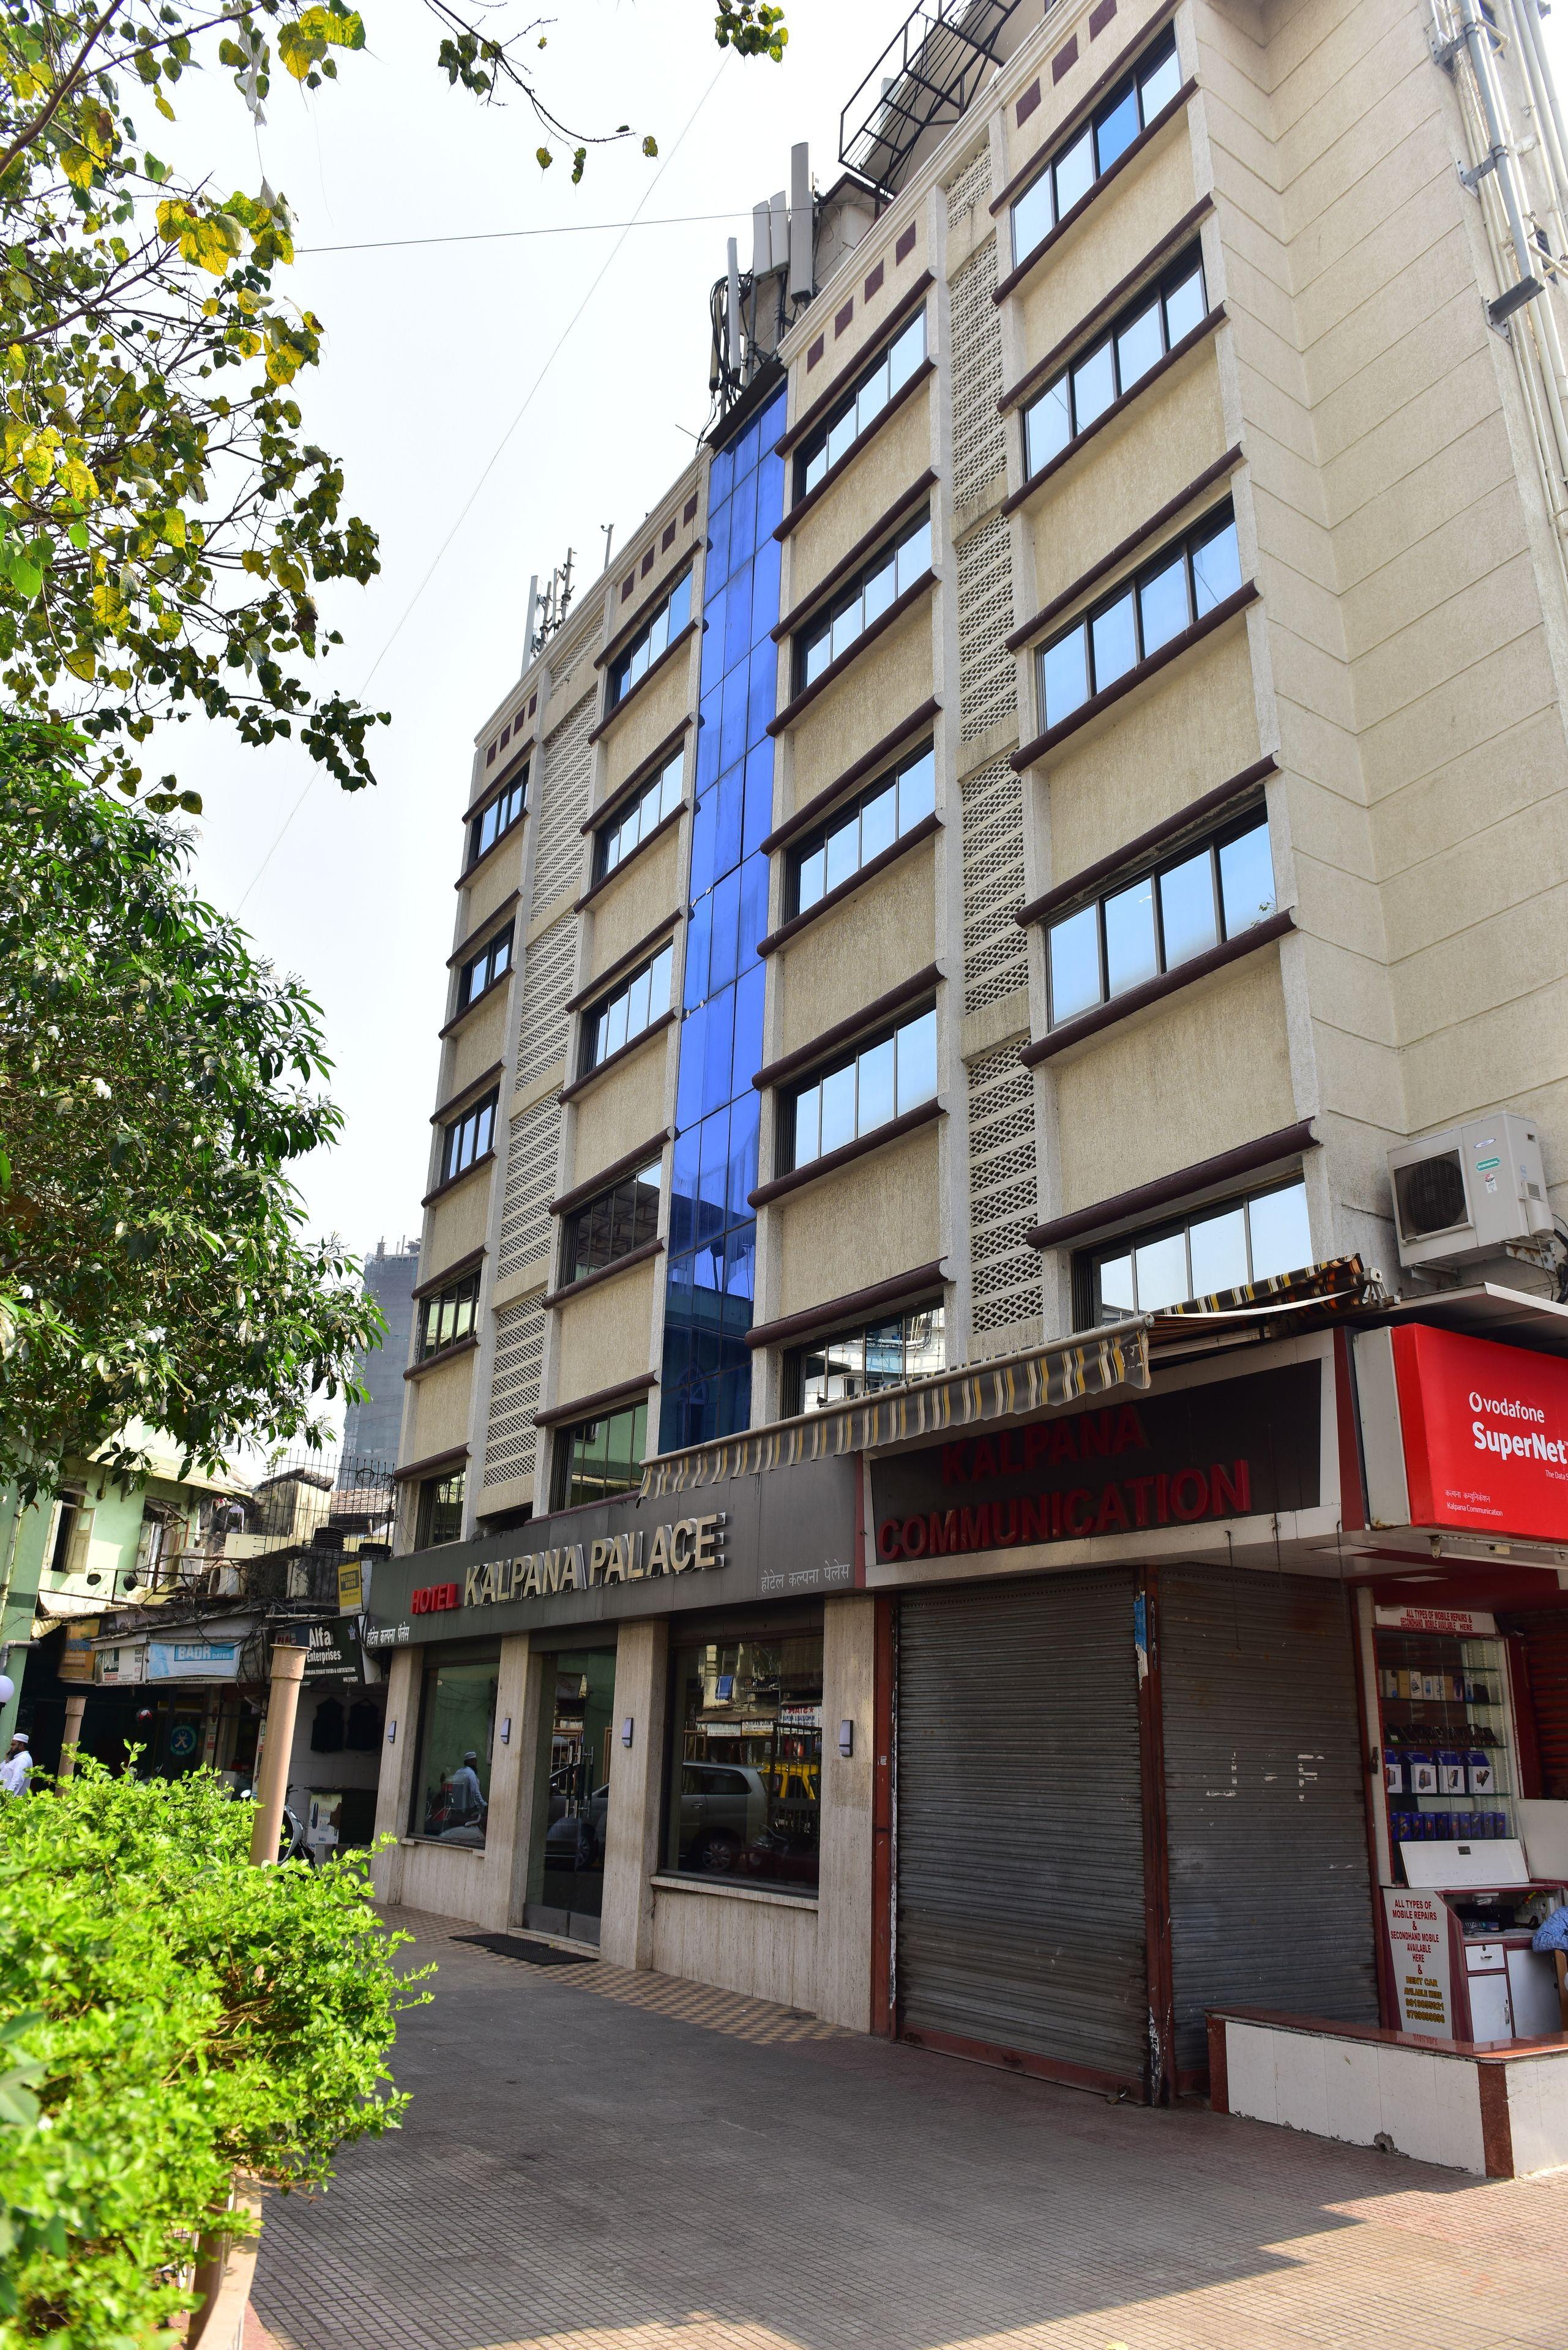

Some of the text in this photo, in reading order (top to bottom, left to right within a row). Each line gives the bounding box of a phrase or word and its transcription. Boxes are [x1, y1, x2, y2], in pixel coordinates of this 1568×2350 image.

[1483, 1398, 1545, 1423] vodafone
[942, 1405, 1151, 1486] KALPANA
[1472, 1422, 1567, 1464] SuperNet
[1545, 1469, 1555, 1479] The
[1555, 1471, 1566, 1481] Data
[1445, 1490, 1461, 1499] कल्पना
[878, 1458, 1251, 1561] COMMUNICATION
[1447, 1502, 1503, 1516] Kalpana Communication
[411, 1512, 726, 1615] HOTEL KALPANA PALACE
[761, 1559, 850, 1593] होटेल कल्पना पेलेस
[1414, 1610, 1428, 1619] TYPES
[1428, 1610, 1434, 1620] OF
[1434, 1611, 1450, 1621] MOBILE
[1450, 1613, 1467, 1623] REPAIRS
[1468, 1614, 1473, 1624] &
[1400, 1617, 1473, 1632] SECONDHAND MOBILE AVAILABLE HERE
[309, 1627, 331, 1648] Alfa
[380, 1628, 396, 1644] कल्पना
[178, 1645, 211, 1660] BADR
[307, 1648, 342, 1665] Enterprises
[1395, 1899, 1432, 1909] ALL TYPES OF
[1392, 1910, 1437, 1920] MOBILE REPAIRS
[1412, 1920, 1417, 1931] &
[1391, 1931, 1439, 1943] SECONDHAND MOBILE
[1407, 1943, 1431, 1953] AVAILABLE
[1413, 1953, 1425, 1963] HERE
[1417, 1964, 1422, 1975] &
[1406, 1976, 1438, 1987] RENT CAR
